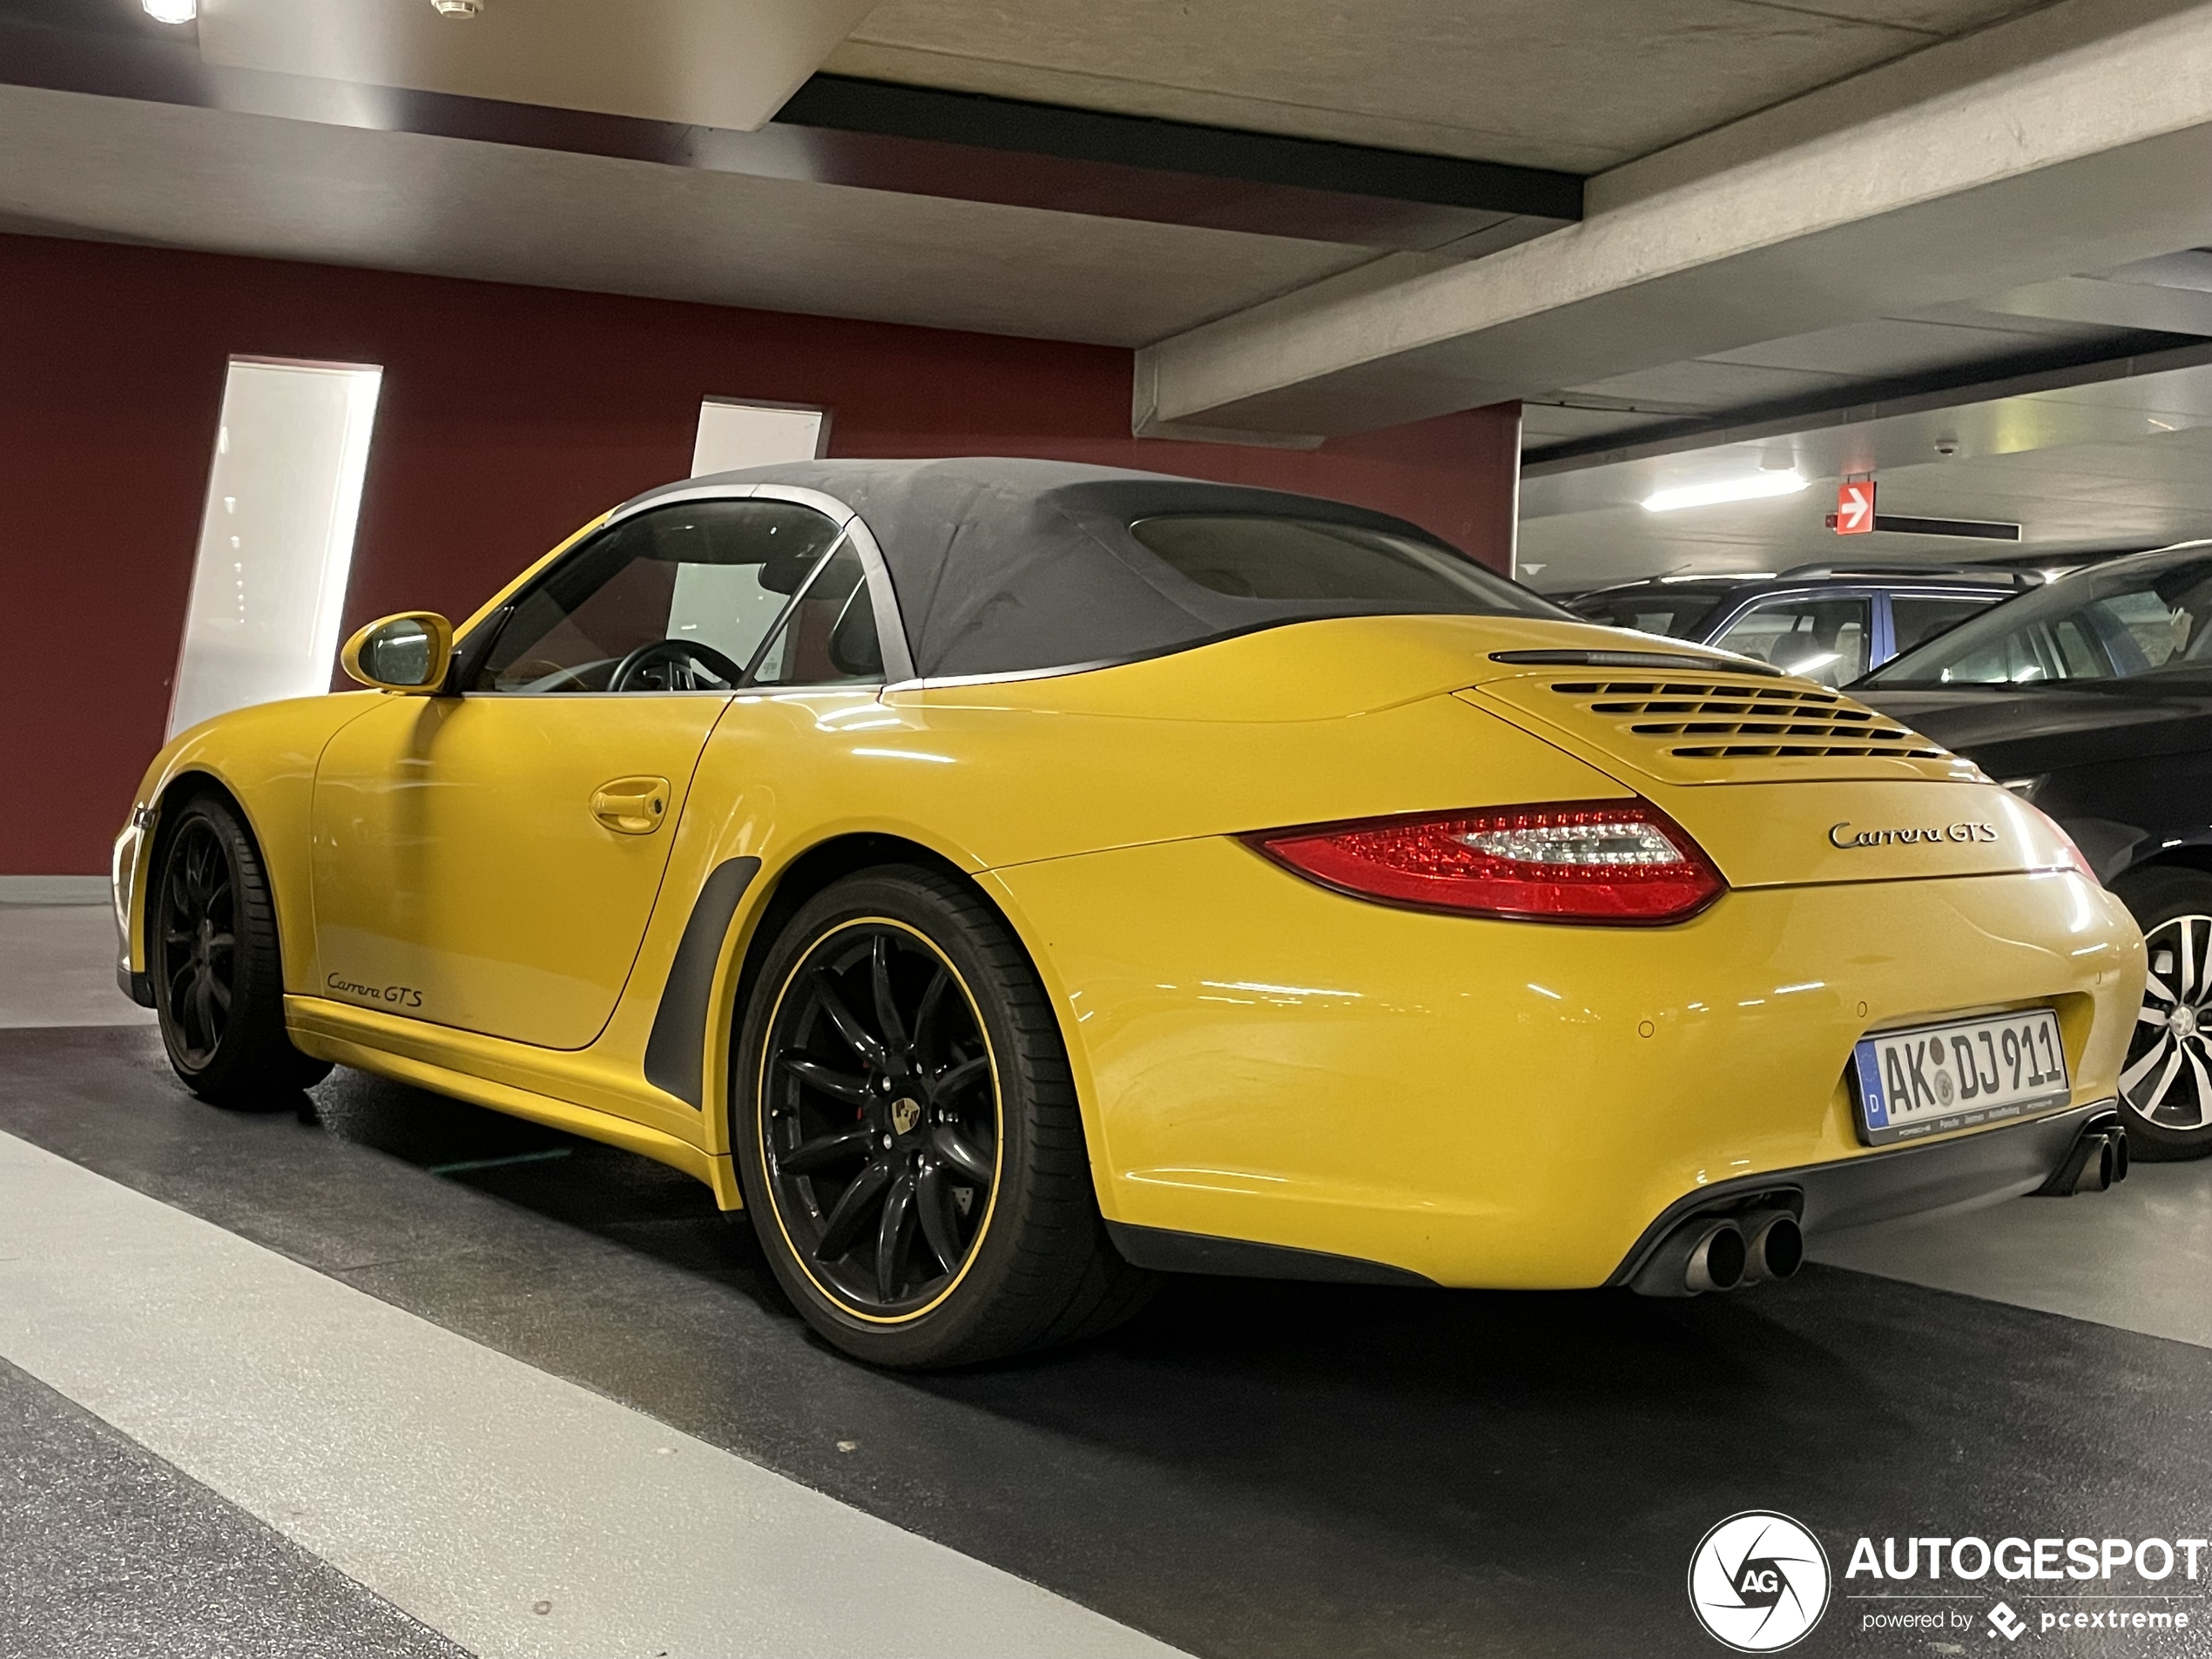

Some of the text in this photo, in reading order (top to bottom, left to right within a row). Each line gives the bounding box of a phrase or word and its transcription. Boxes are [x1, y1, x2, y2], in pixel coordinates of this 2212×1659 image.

[1829, 821, 2000, 849] Carrera GTS
[327, 972, 423, 1008] Carrera GTS
[1885, 1021, 2061, 1114] AK DJ 911
[1869, 1094, 1879, 1113] D
